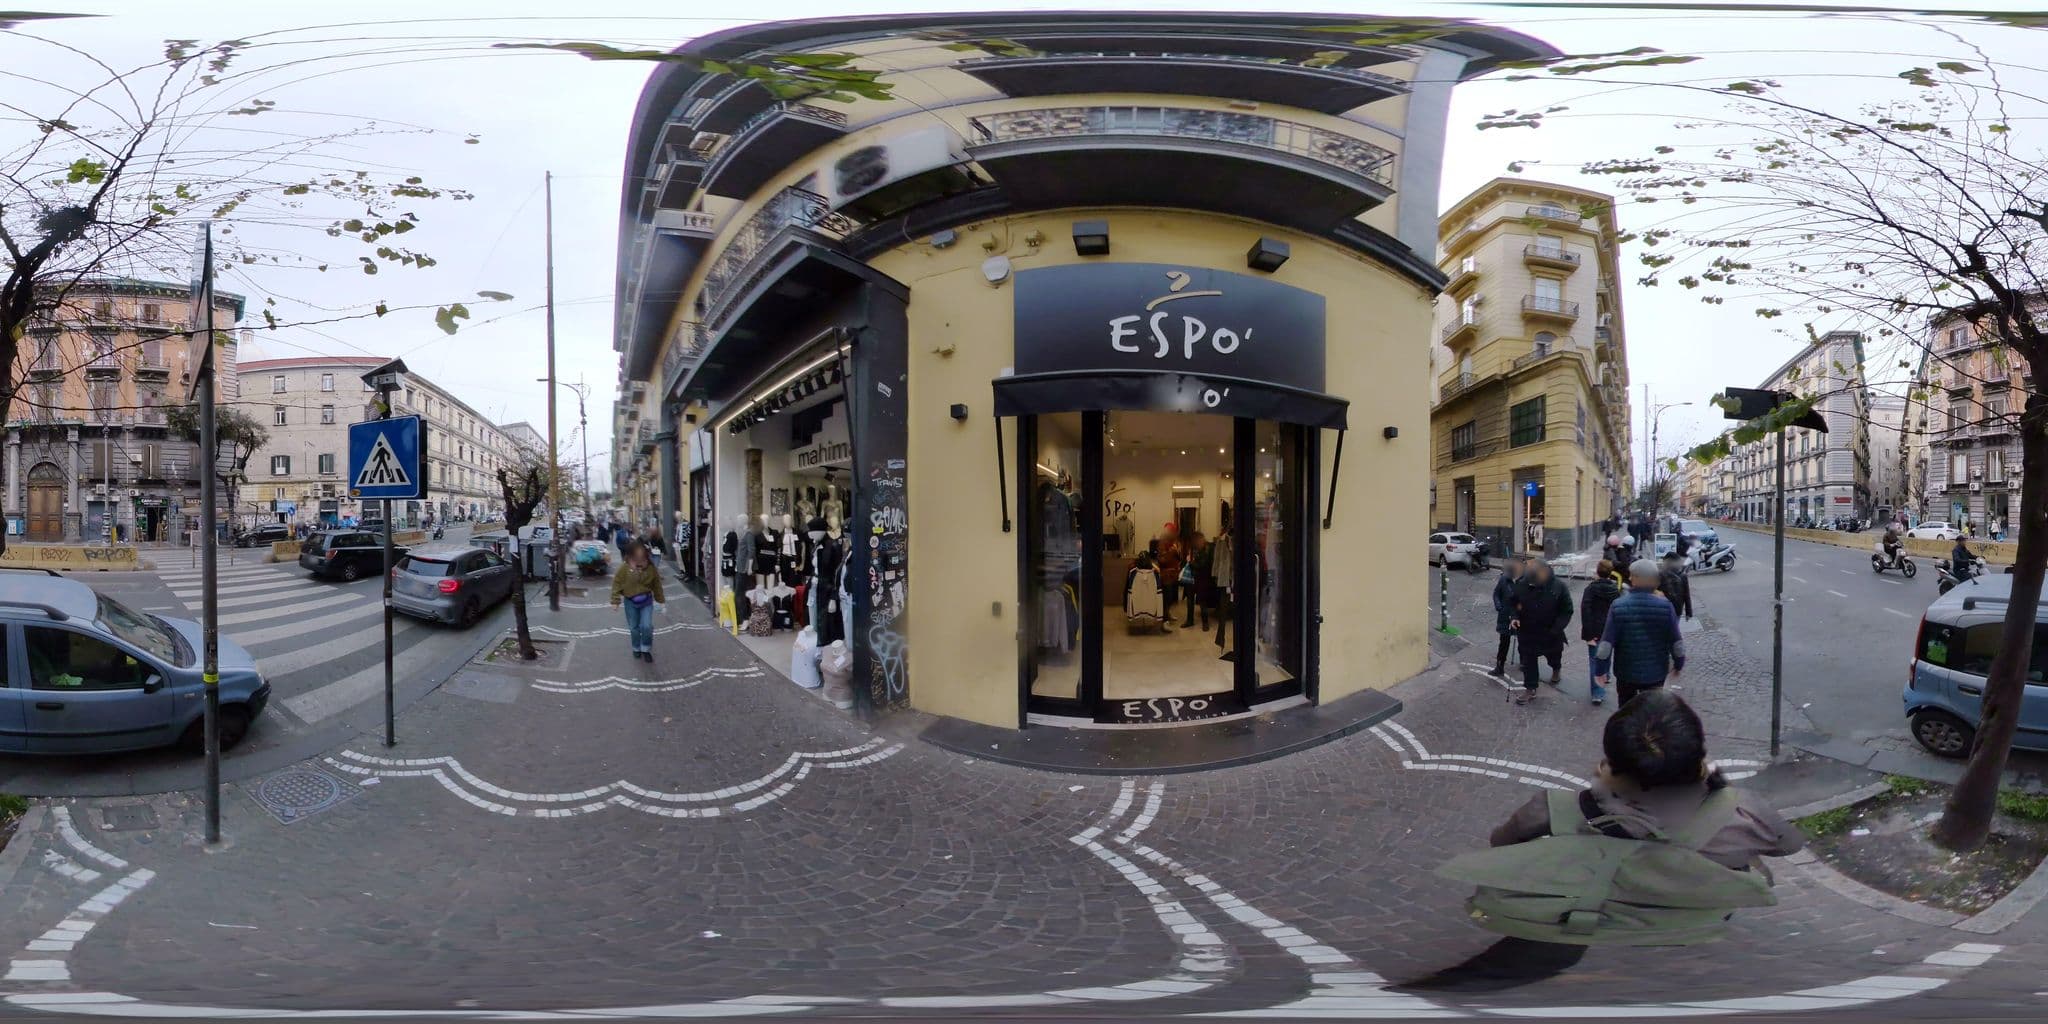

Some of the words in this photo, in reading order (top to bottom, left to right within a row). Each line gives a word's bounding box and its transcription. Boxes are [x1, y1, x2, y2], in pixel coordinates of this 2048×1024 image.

[1109, 312, 1253, 360] ESPO'
[1104, 499, 1136, 517] SPO'
[1122, 697, 1216, 719] ESPO'
